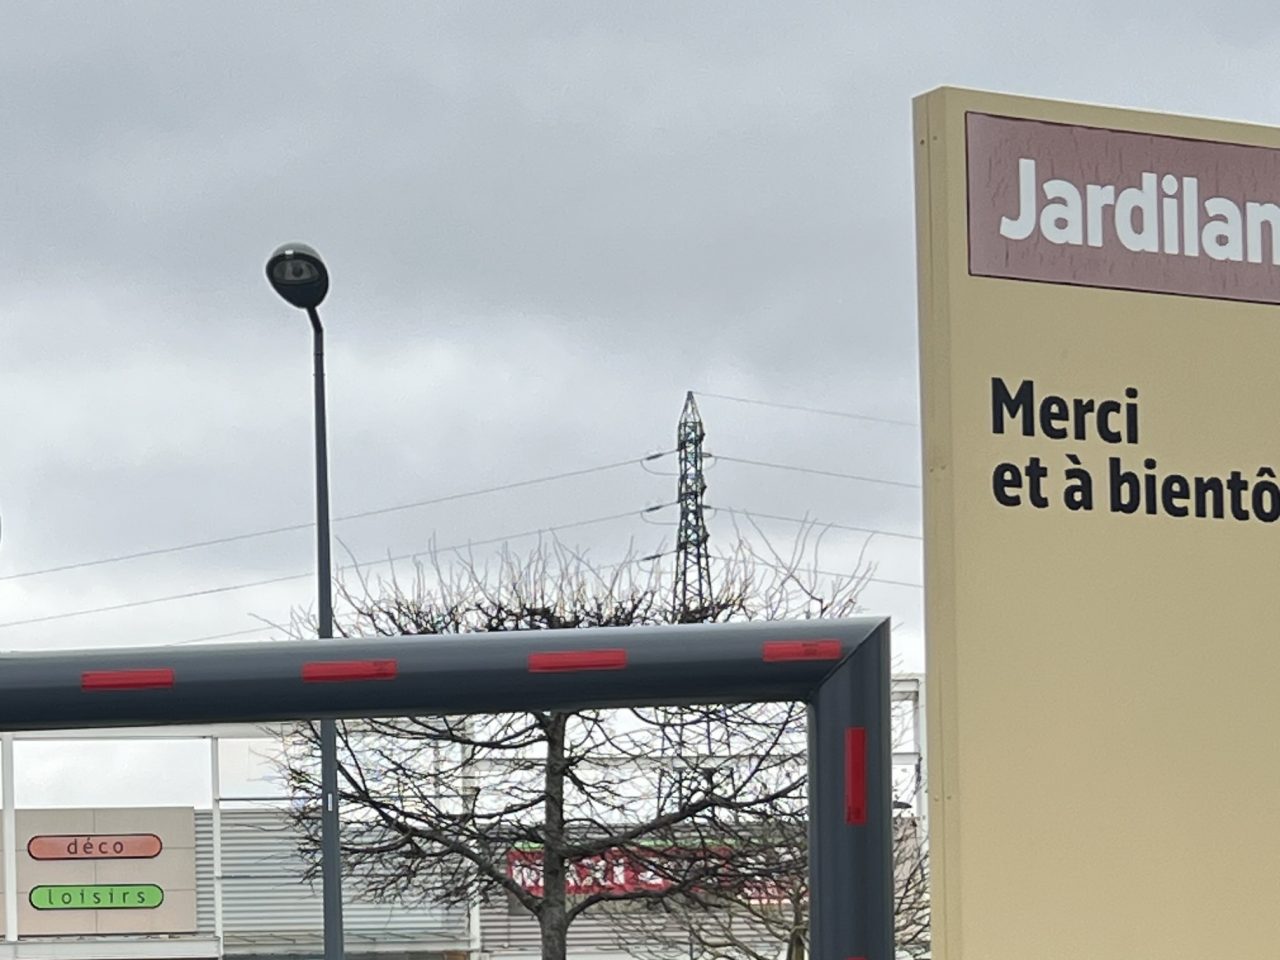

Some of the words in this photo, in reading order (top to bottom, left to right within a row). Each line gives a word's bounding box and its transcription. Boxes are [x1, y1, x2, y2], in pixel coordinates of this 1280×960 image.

[991, 377, 1139, 444] Merci
[992, 456, 1050, 509] et
[1063, 454, 1094, 511] à
[1109, 456, 1280, 523] bientô
[67, 837, 124, 855] déco
[48, 888, 146, 905] loisirs
